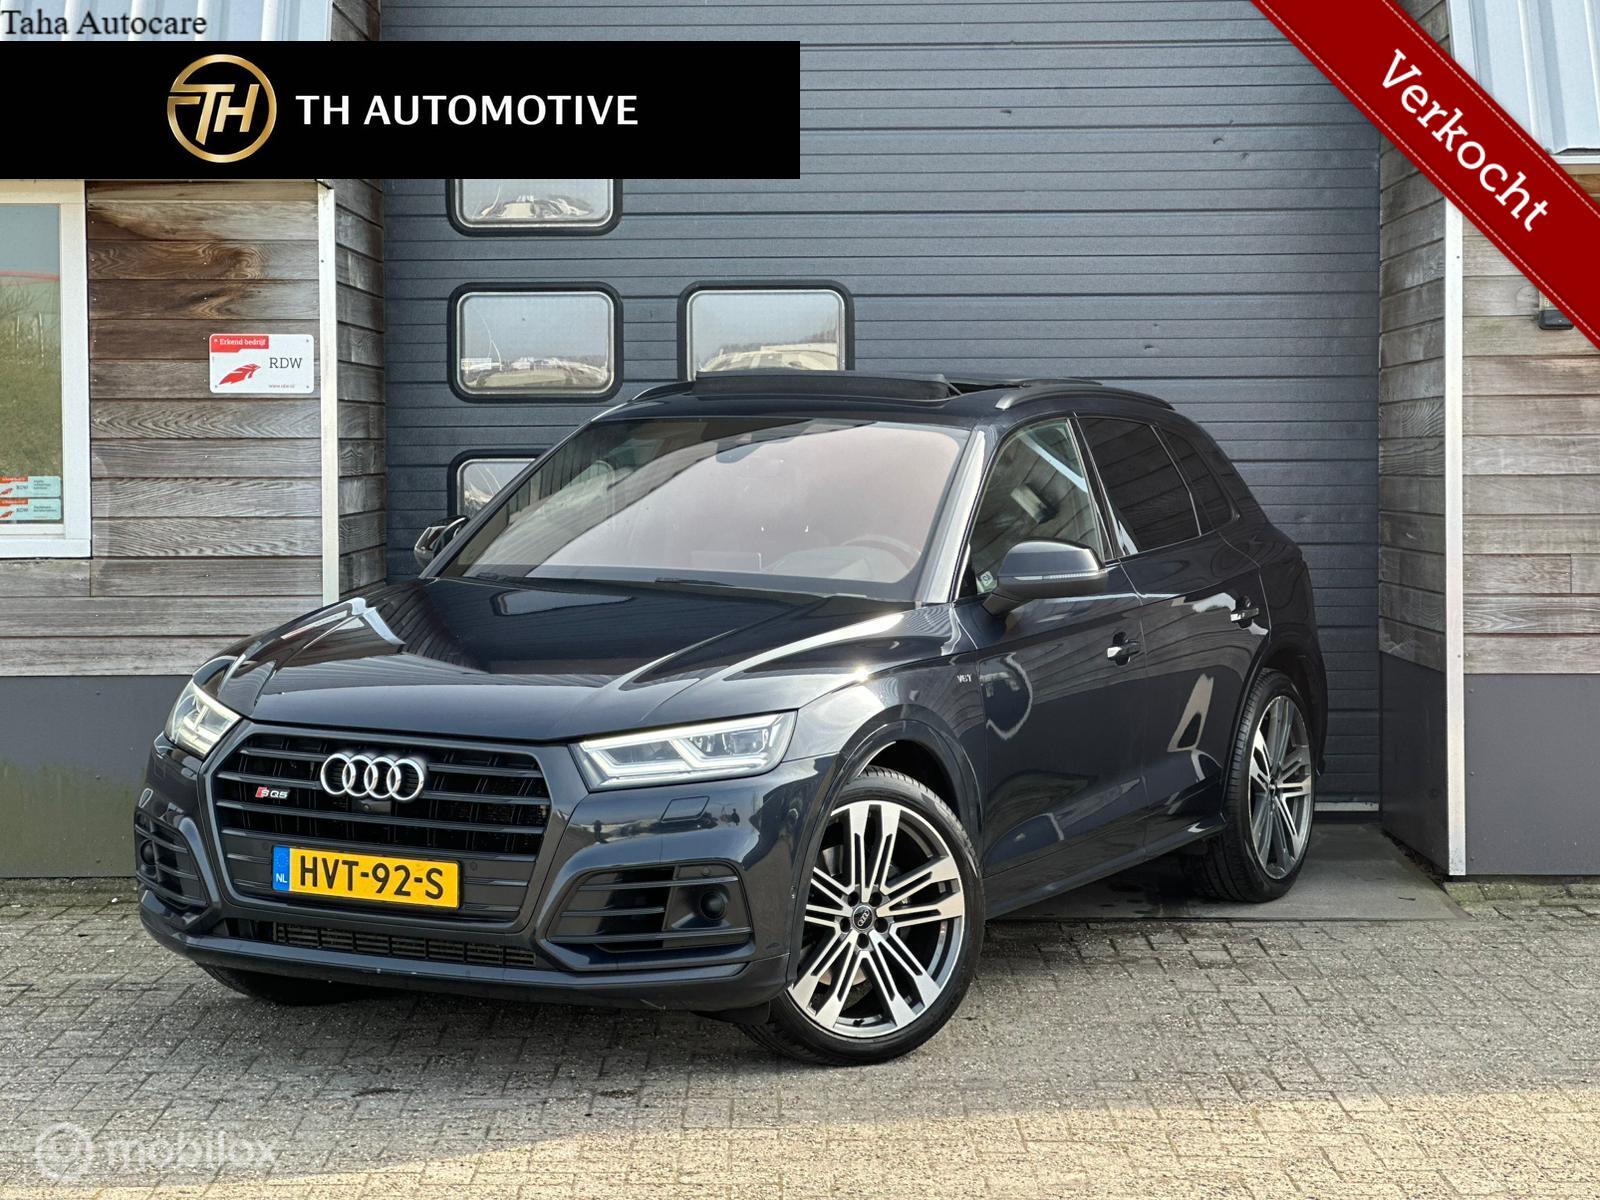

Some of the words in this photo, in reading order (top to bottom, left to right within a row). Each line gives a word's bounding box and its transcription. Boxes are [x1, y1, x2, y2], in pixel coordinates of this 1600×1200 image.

[220, 338, 243, 346] Erkend
[269, 357, 303, 368] RDW
[276, 873, 288, 884] NL
[299, 855, 444, 900] HVT-92-S
